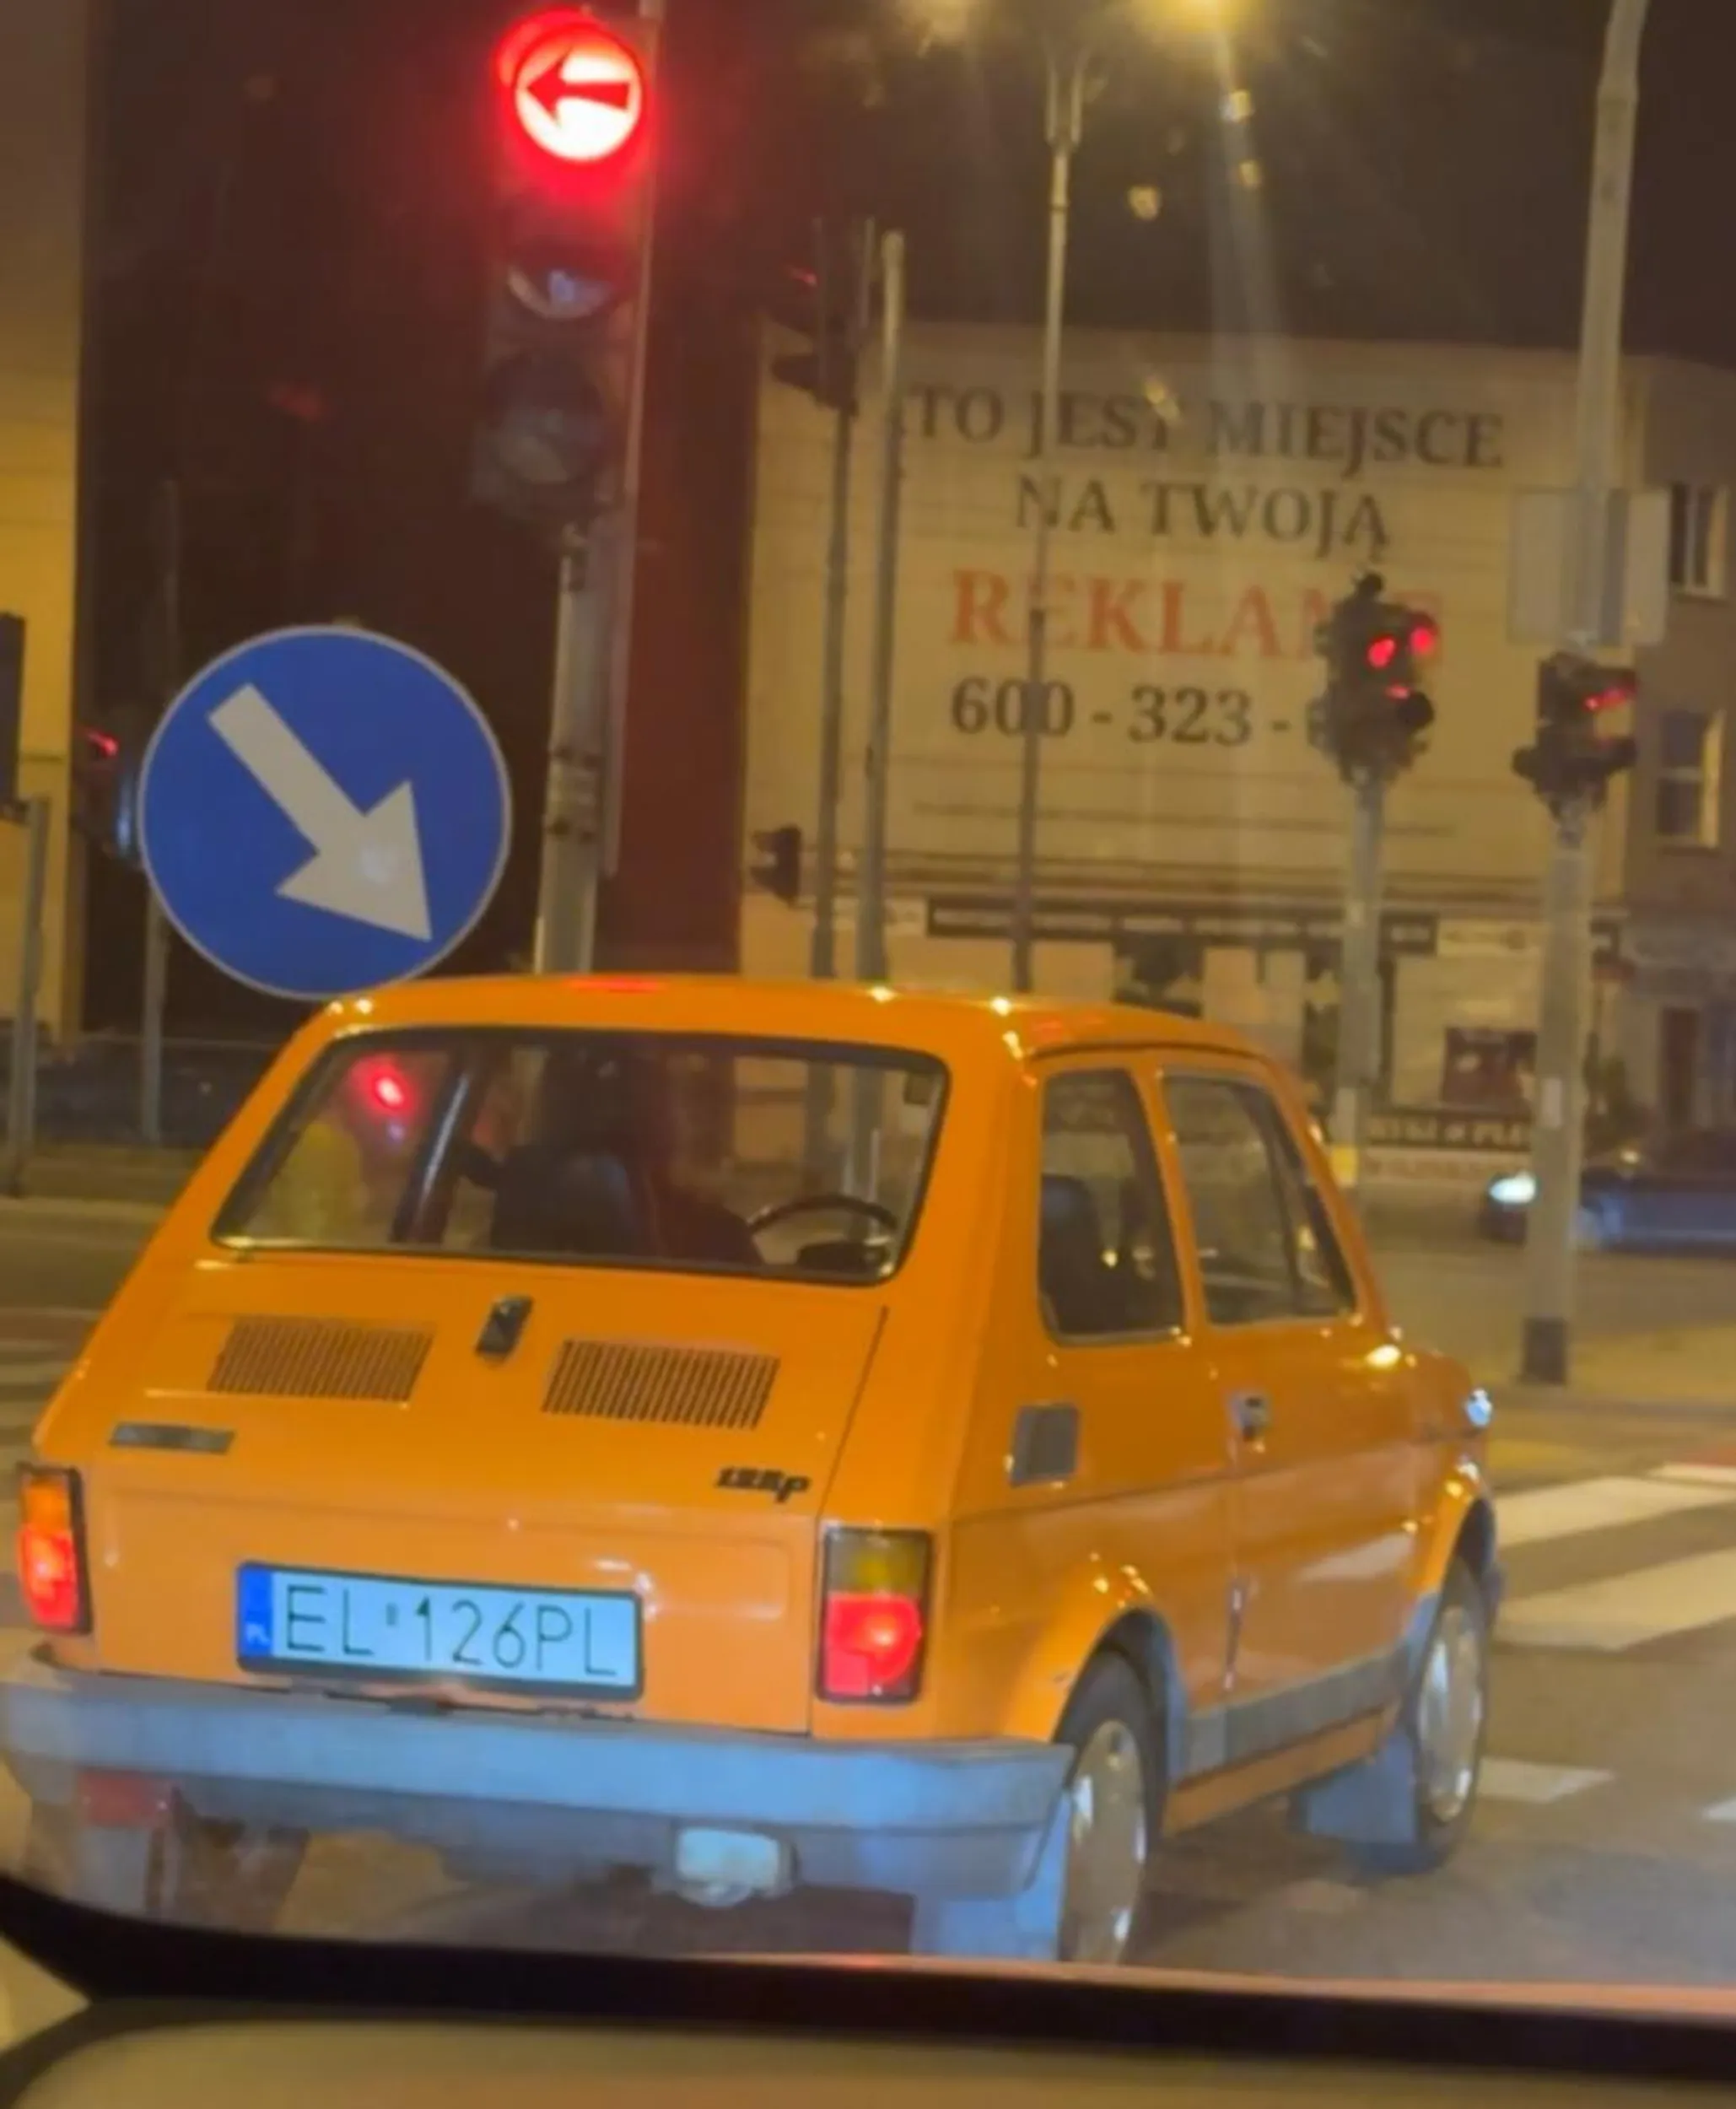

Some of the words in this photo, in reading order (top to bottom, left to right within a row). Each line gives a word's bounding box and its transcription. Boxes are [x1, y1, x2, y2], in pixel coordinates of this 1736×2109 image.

[906, 383, 1005, 445] TO
[1022, 388, 1178, 460] JEST
[1207, 400, 1505, 483] MIEJSCE
[1015, 474, 1116, 533] NA
[1140, 481, 1390, 564] TWOJĄ
[952, 675, 1076, 739] 600
[1127, 683, 1253, 747] 323
[286, 1583, 374, 1657] EL
[416, 1594, 617, 1677] 126PL
